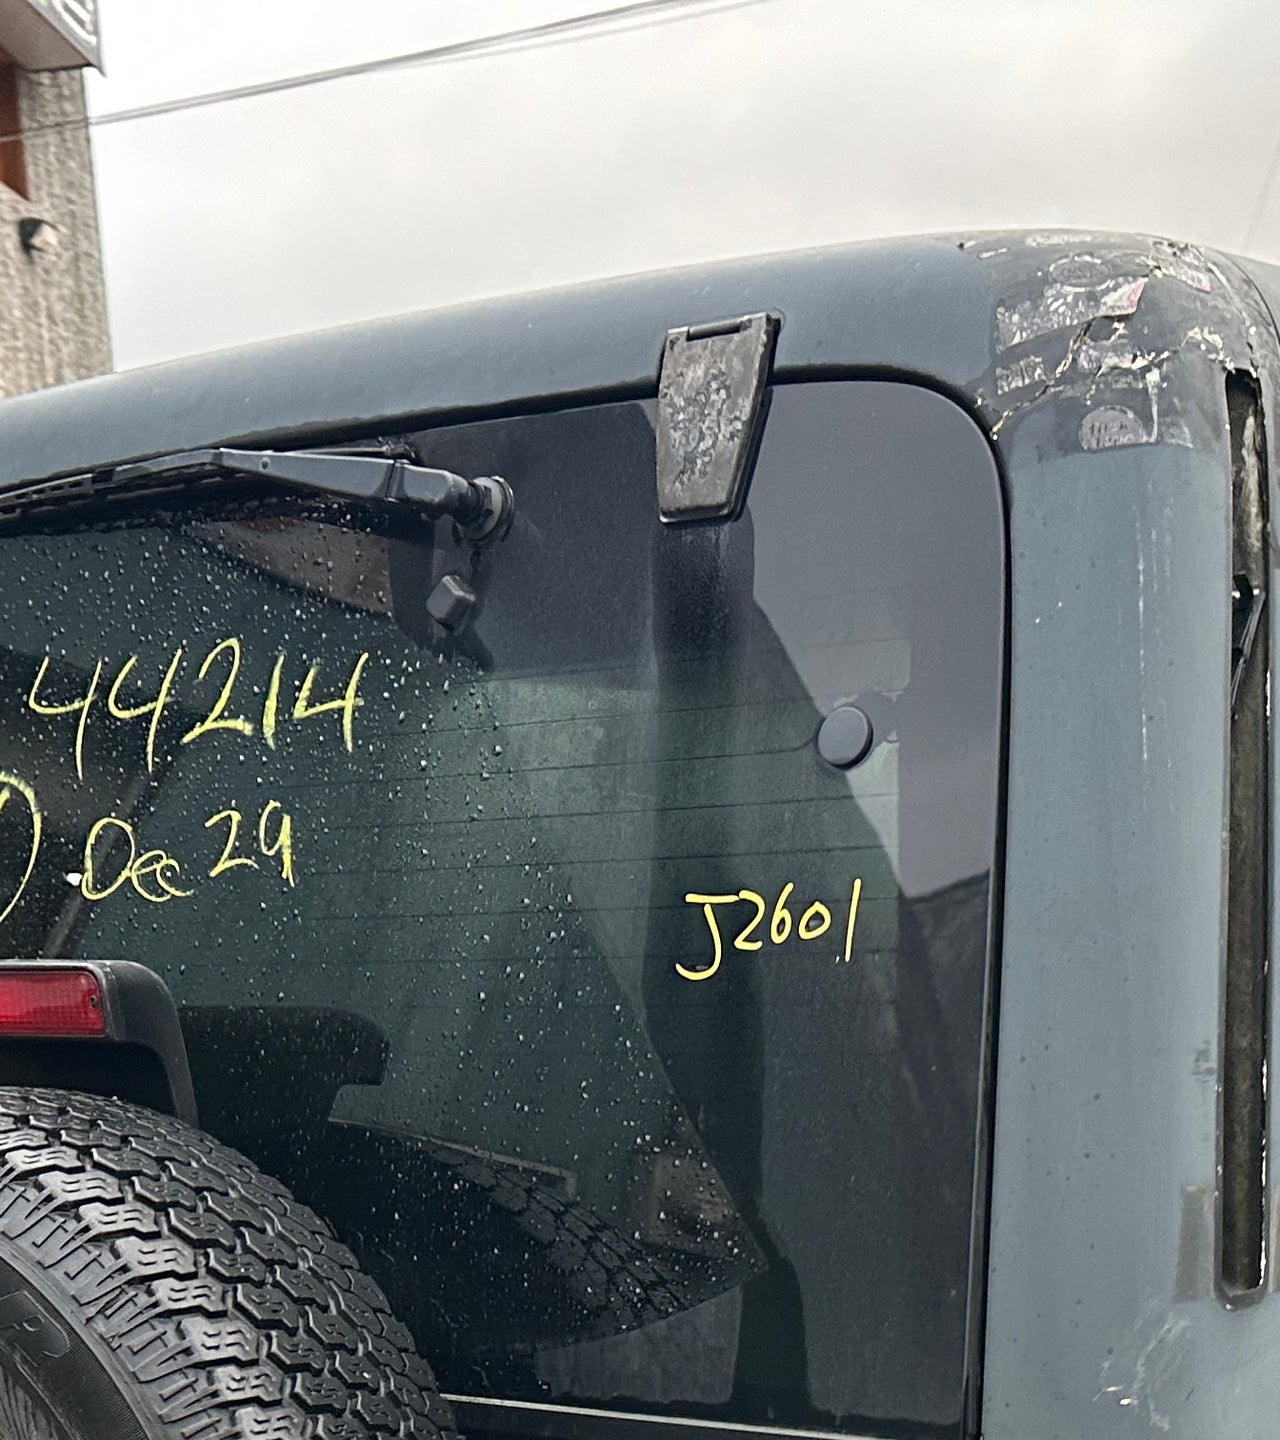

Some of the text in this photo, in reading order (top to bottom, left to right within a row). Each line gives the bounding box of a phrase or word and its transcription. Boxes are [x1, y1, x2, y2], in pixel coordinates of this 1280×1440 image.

[27, 637, 369, 781] 44214
[80, 801, 299, 903] Dec 29
[674, 878, 862, 981] J2601
